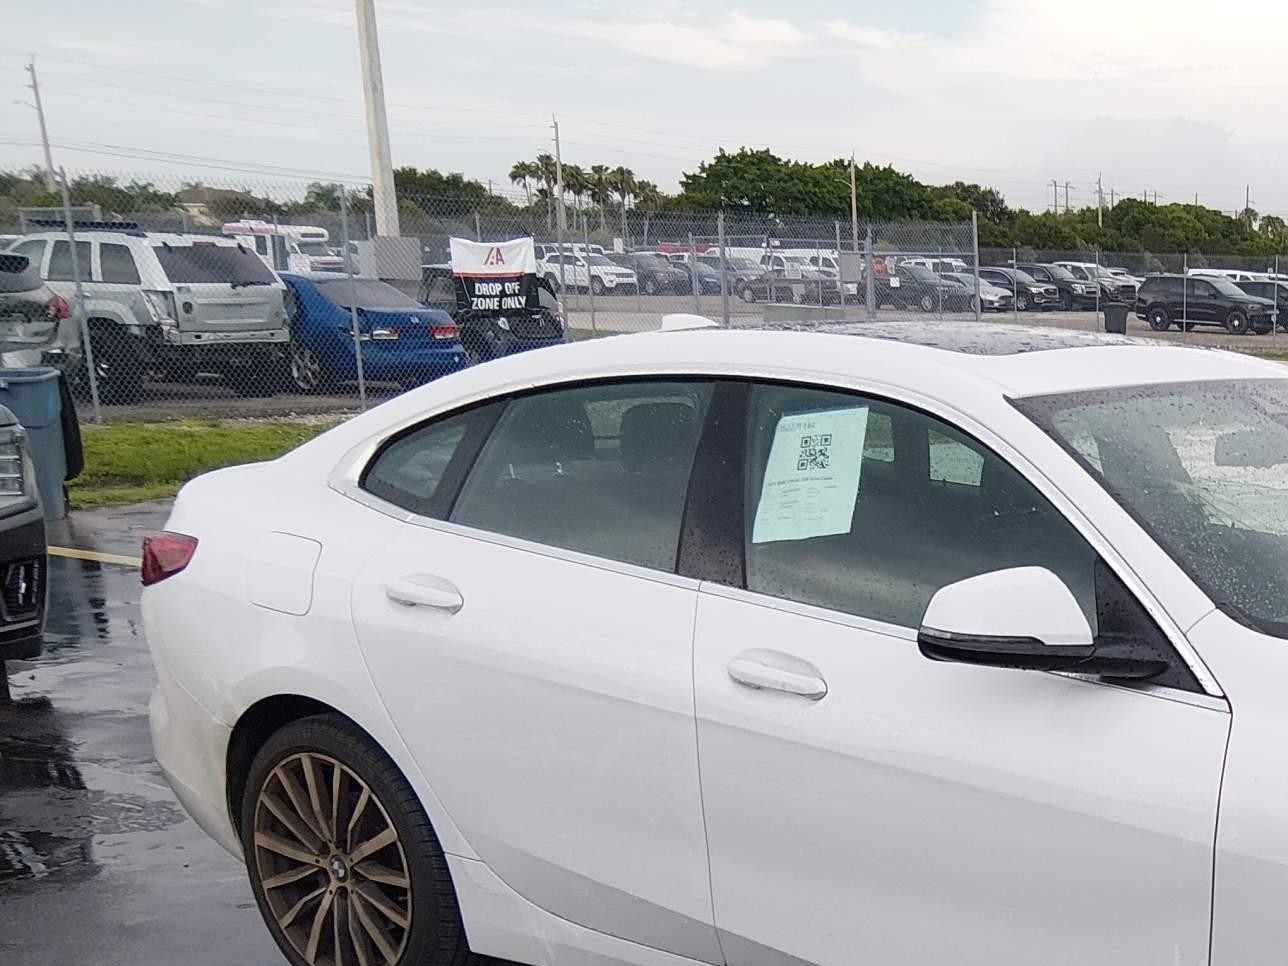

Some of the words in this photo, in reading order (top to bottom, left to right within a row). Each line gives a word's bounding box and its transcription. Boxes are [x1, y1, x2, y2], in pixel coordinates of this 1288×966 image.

[474, 282, 503, 296] DROP
[504, 282, 521, 295] OFF
[471, 297, 500, 310] ZONE
[501, 295, 527, 309] ONLY
